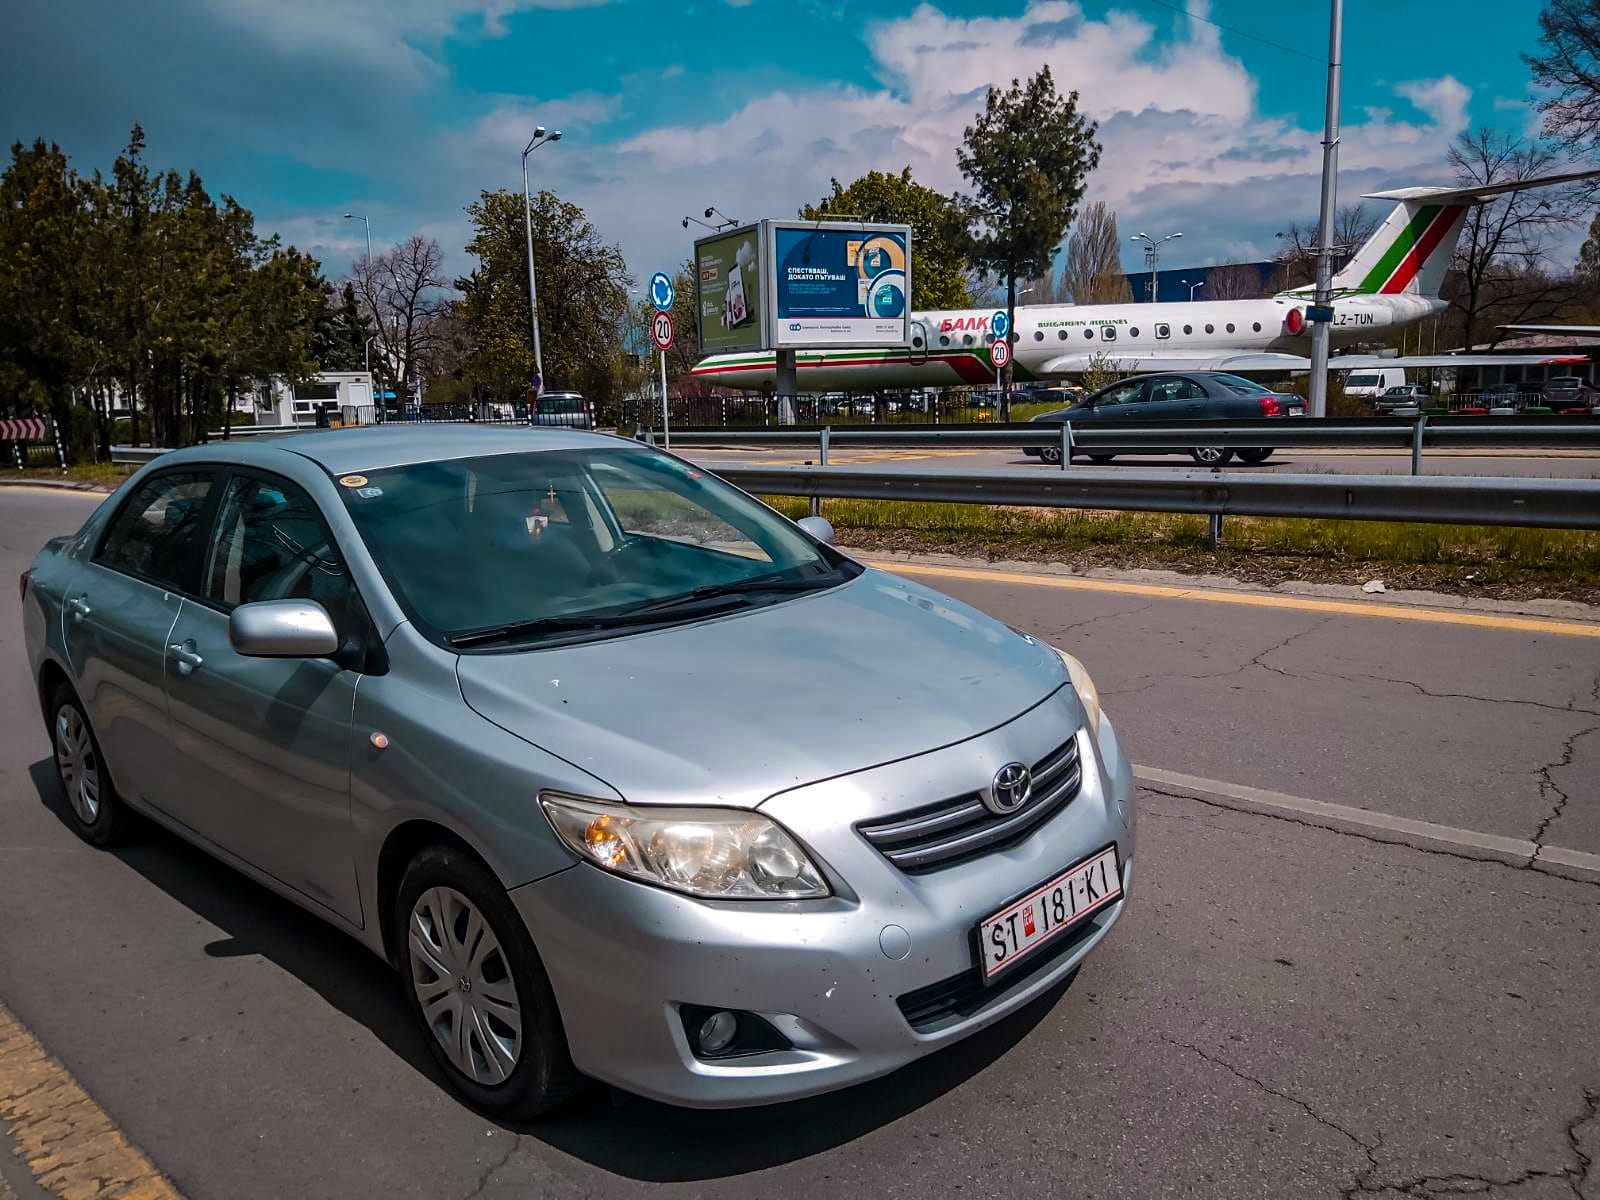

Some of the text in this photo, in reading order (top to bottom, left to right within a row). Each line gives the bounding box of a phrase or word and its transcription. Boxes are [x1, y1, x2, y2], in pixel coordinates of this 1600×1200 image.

[940, 316, 992, 332] БАЛК
[1037, 318, 1128, 328] BULGARIAN AIRLINES
[1333, 312, 1374, 326] LZ-TUN
[656, 320, 670, 340] 20
[994, 346, 1005, 360] 20
[991, 860, 1109, 962] ST 181-KI
